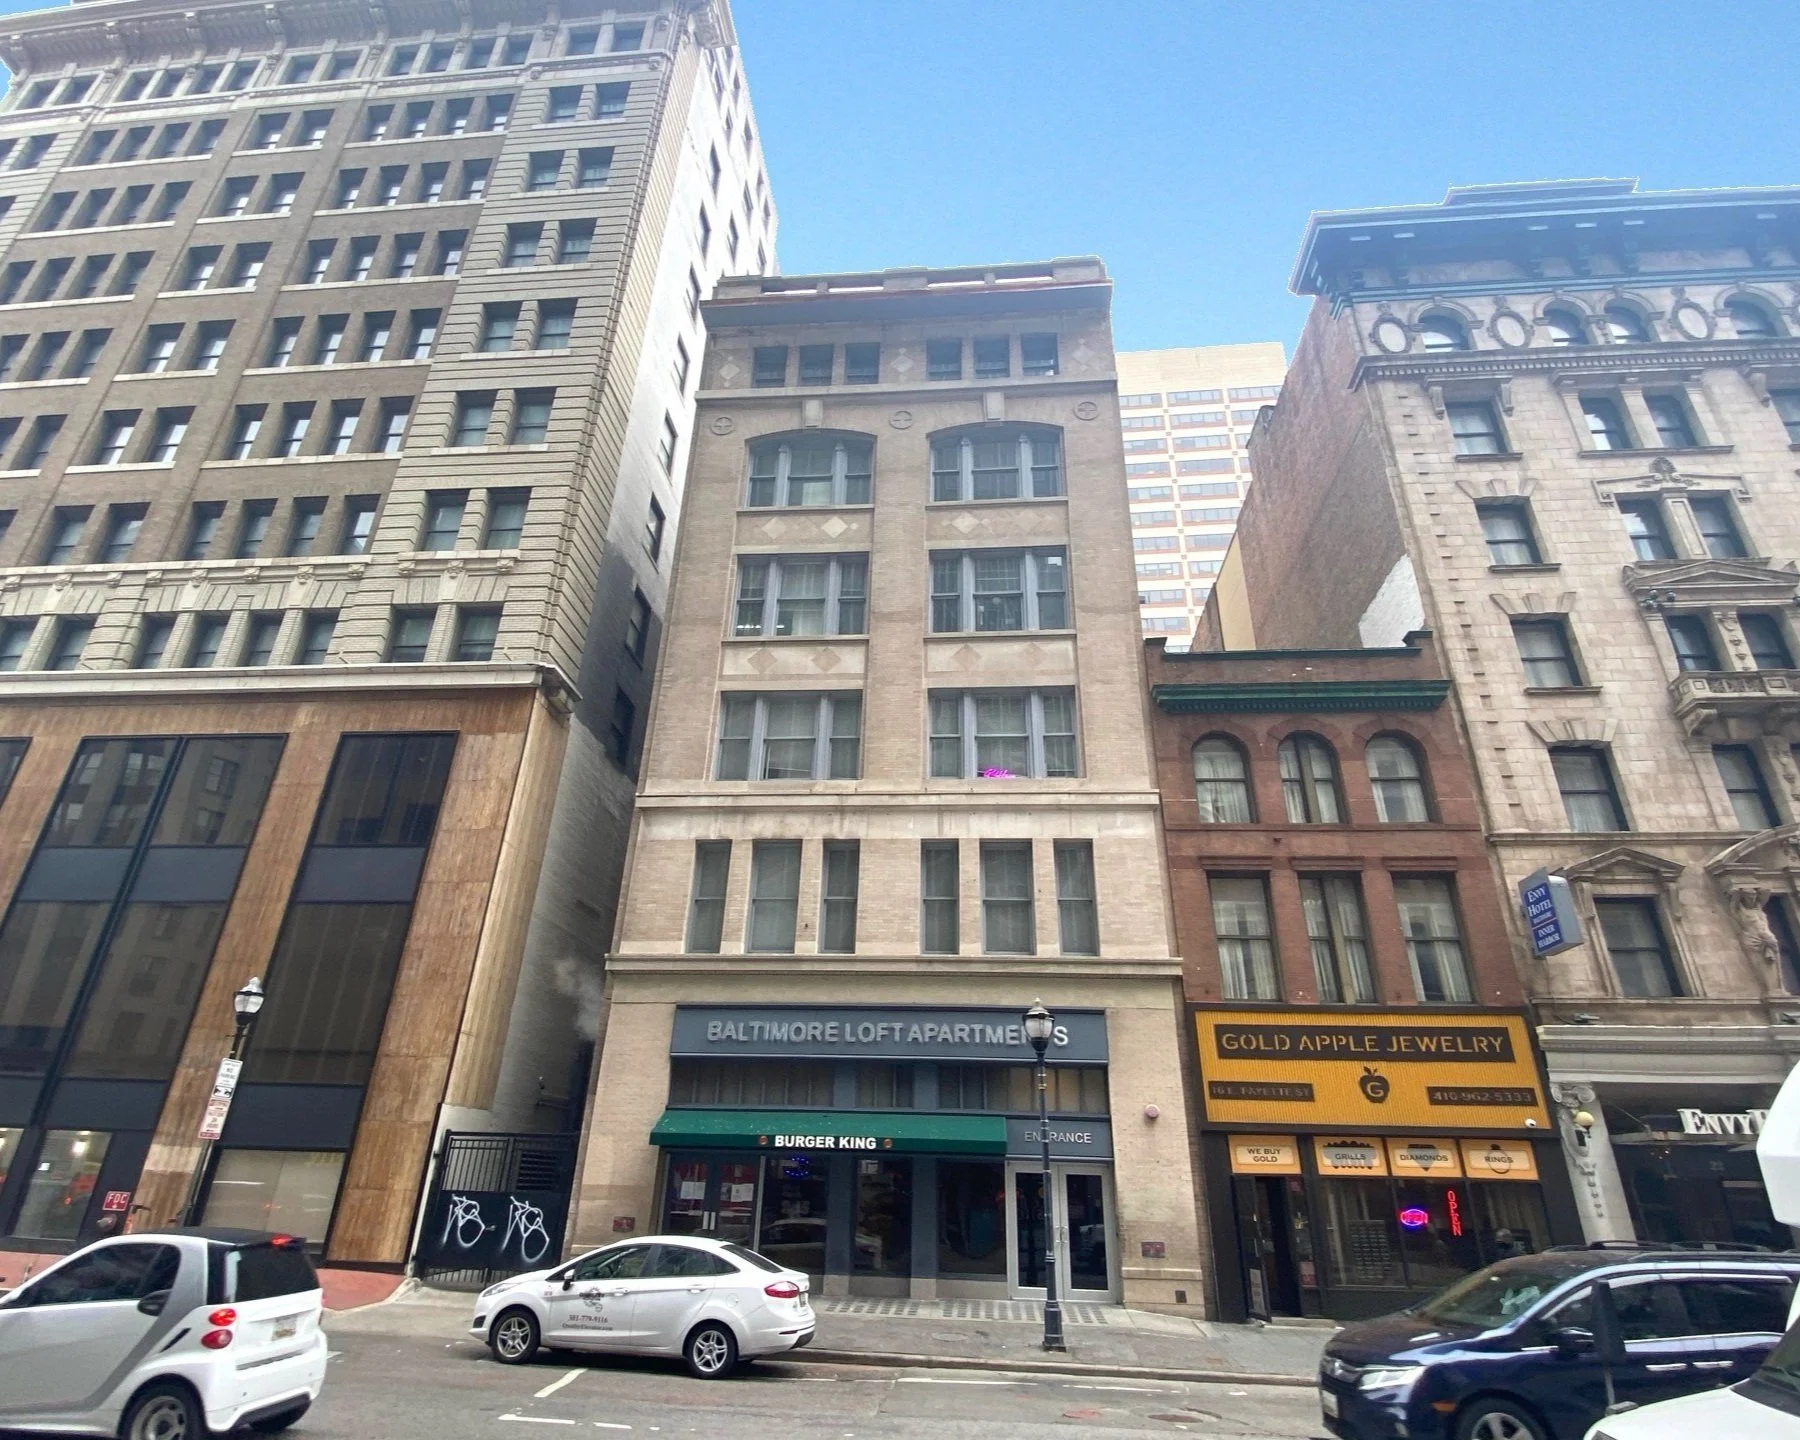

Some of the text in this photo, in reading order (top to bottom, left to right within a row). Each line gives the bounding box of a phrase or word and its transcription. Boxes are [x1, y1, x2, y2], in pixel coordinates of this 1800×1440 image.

[1528, 899, 1552, 917] HOTEL
[707, 1020, 1069, 1047] BALTIMORE LOFT APARTMES
[1222, 1033, 1503, 1053] GOLD APPLE JEWELRY
[1367, 1081, 1384, 1098] G
[774, 1134, 877, 1149] BURGER KING
[1024, 1131, 1092, 1144] ENRANCE
[1247, 1147, 1261, 1155] WE
[1335, 1152, 1367, 1161] GRILLS
[1252, 1155, 1278, 1163] GOLD
[1484, 1155, 1514, 1164] RINGS
[107, 1193, 128, 1204] FDC
[1447, 1190, 1462, 1237] OPEN
